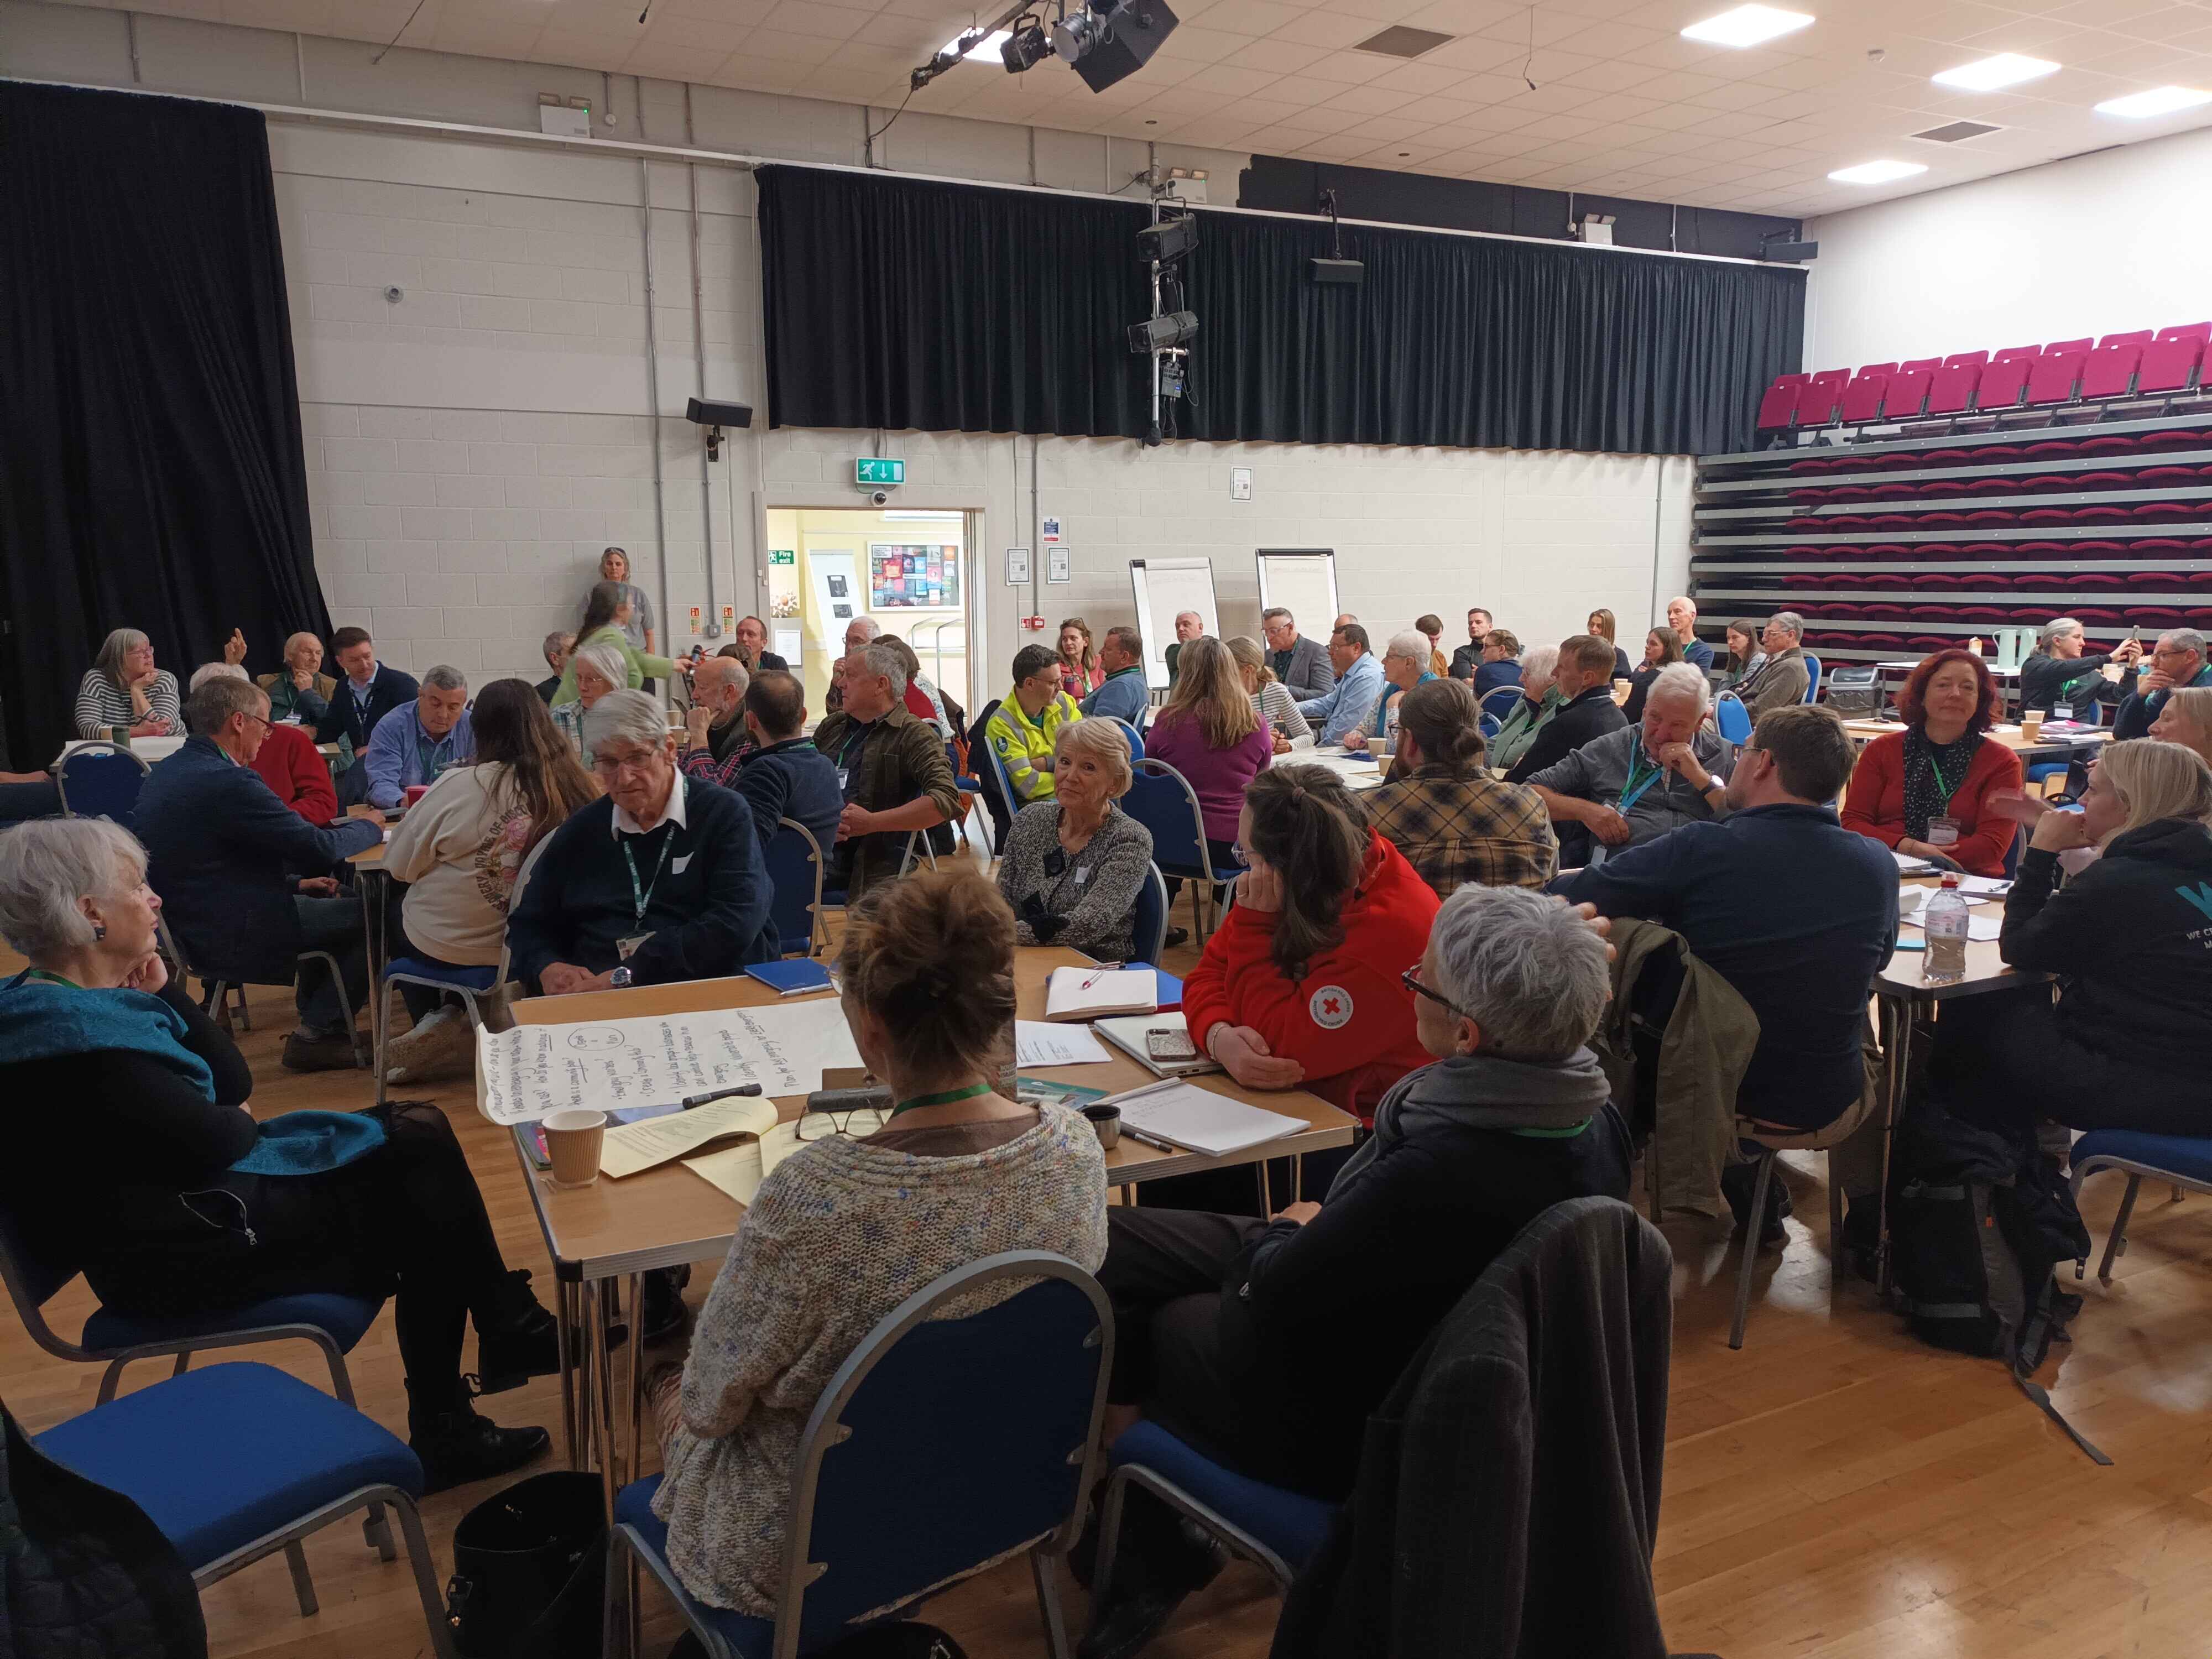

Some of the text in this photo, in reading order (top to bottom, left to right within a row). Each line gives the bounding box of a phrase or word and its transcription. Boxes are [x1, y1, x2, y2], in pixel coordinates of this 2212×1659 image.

[489, 821, 504, 836] OF
[2186, 930, 2201, 940] WE
[784, 1074, 800, 1088] Plan
